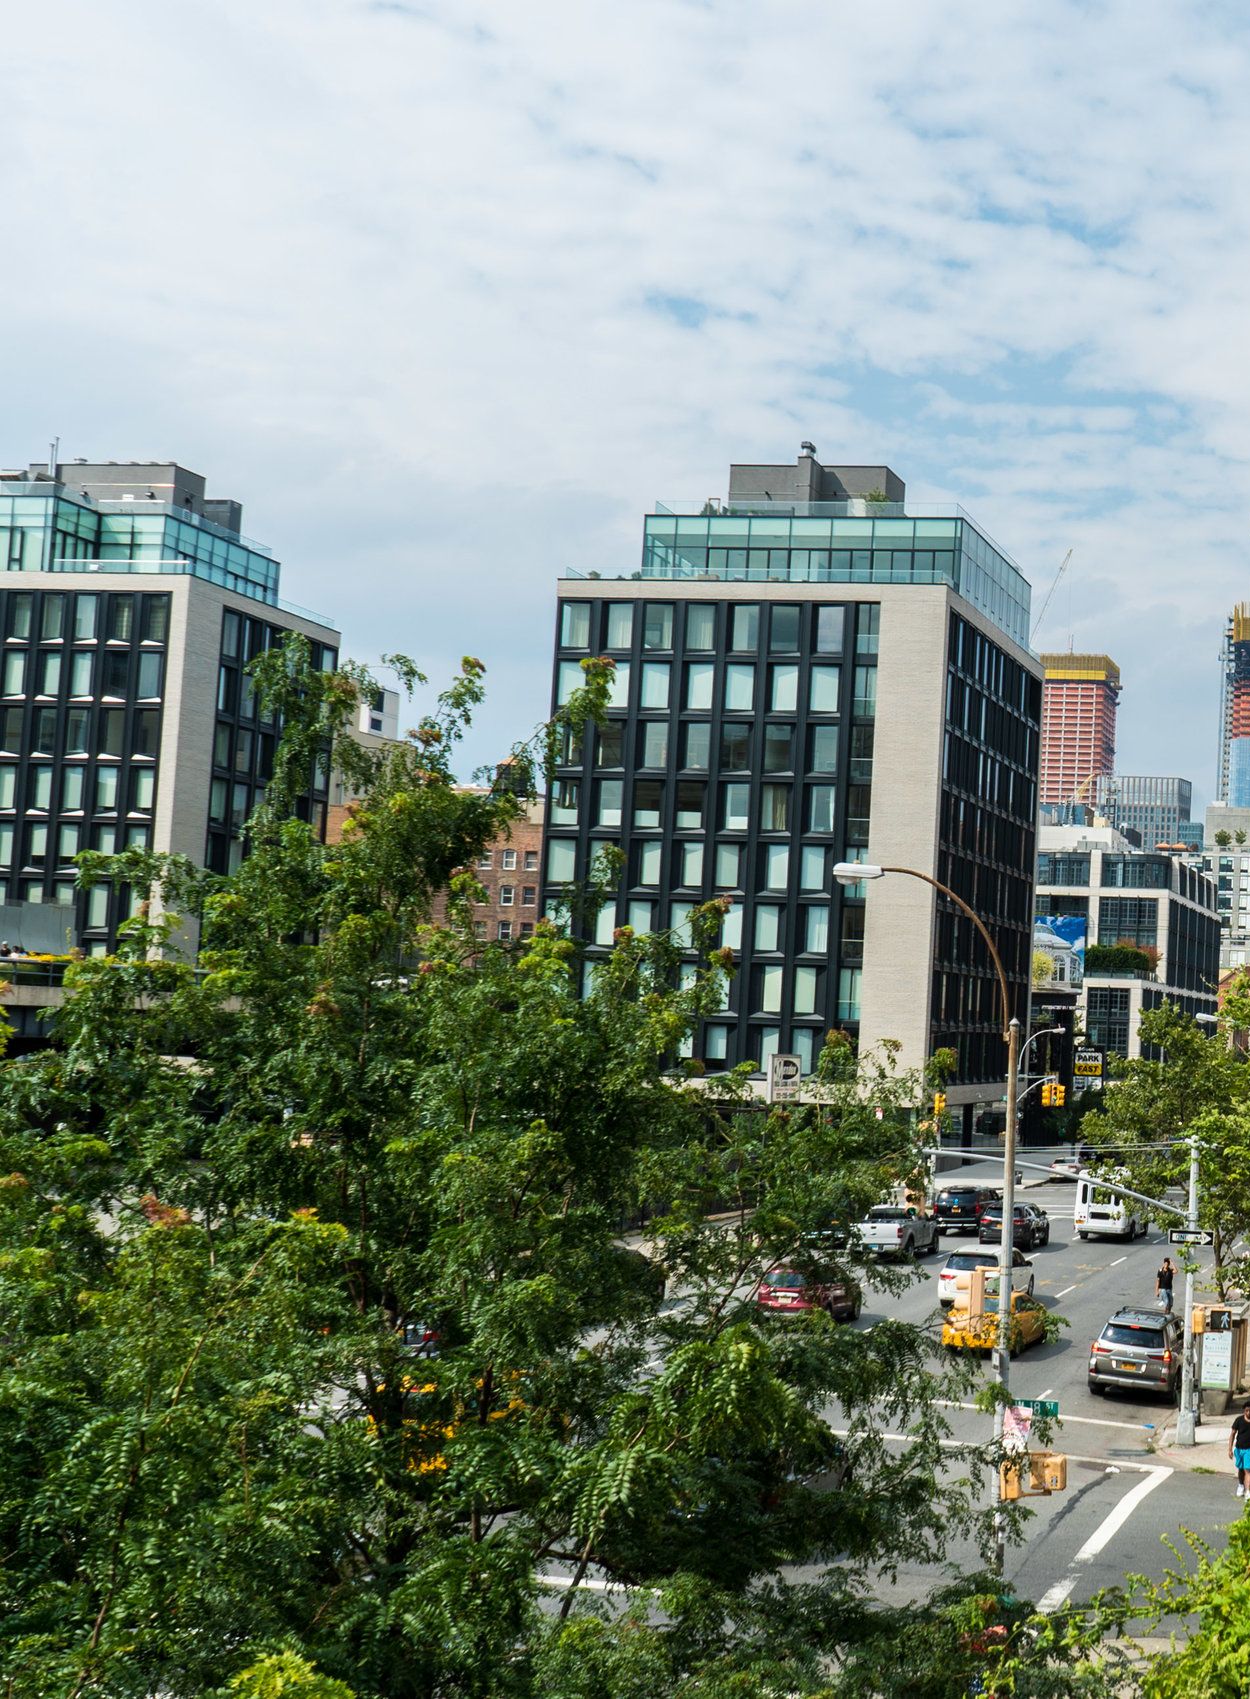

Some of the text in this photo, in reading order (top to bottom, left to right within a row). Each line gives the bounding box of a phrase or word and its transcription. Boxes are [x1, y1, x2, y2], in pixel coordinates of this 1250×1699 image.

[1077, 1054, 1100, 1062] PARK
[1077, 1065, 1100, 1073] FAST
[1046, 1402, 1055, 1410] ST
